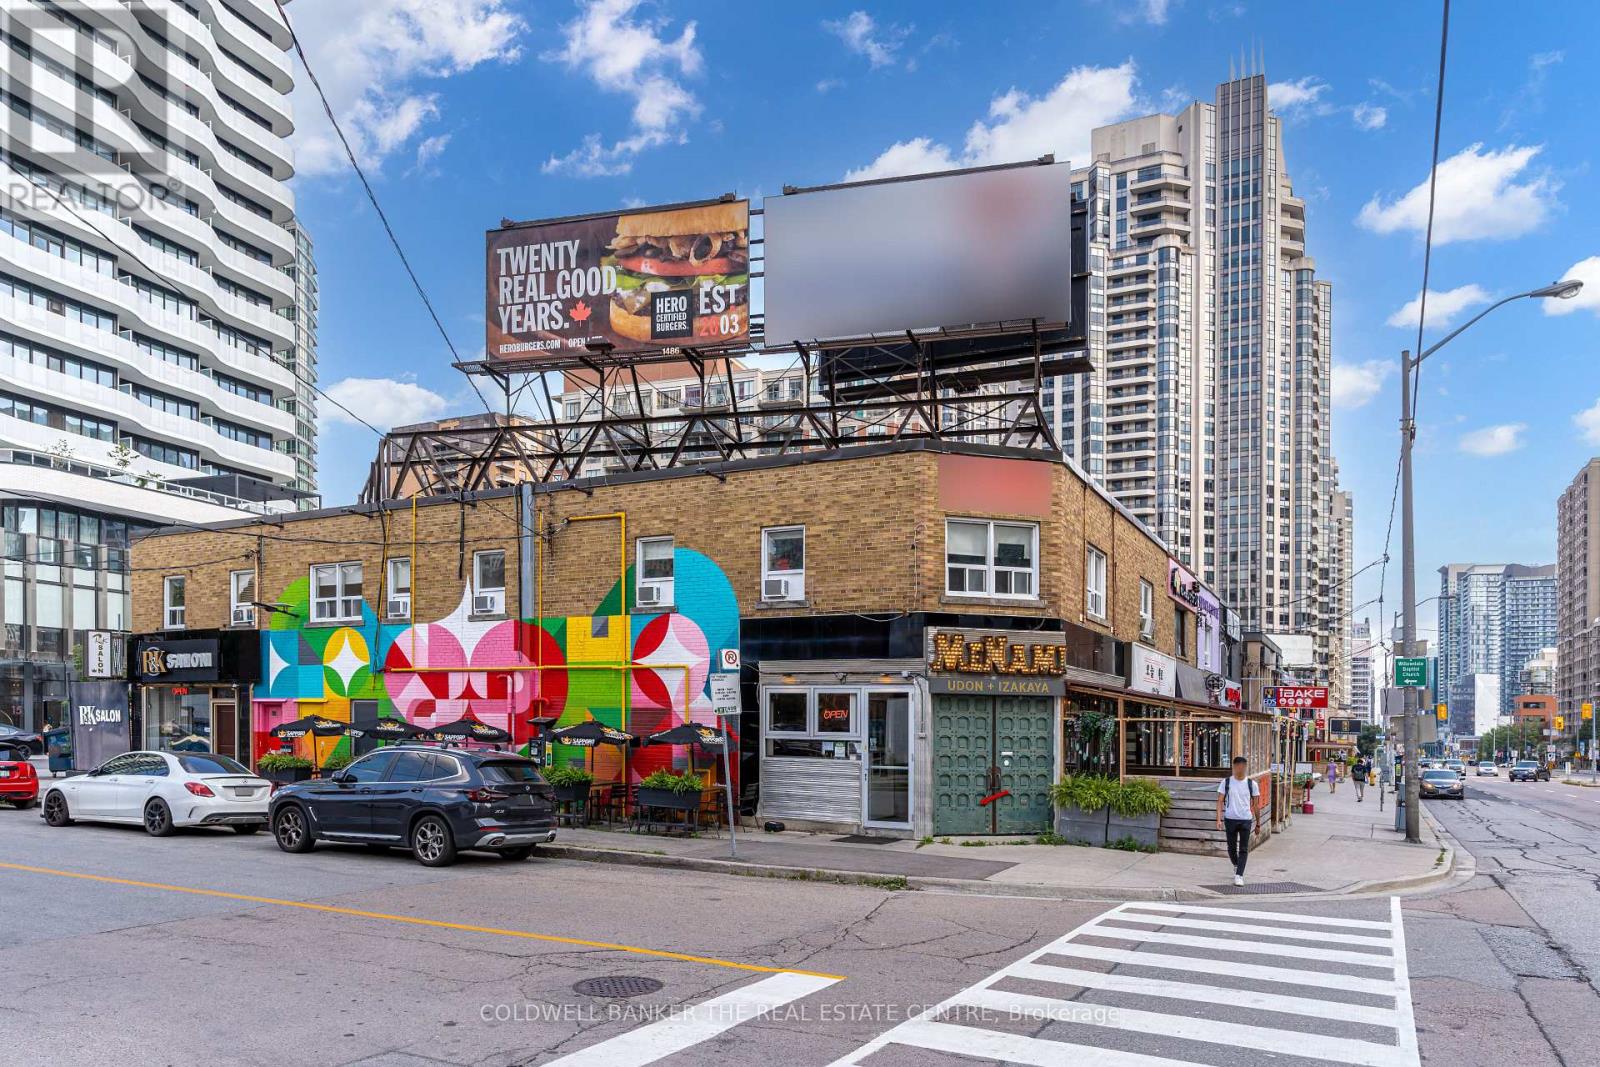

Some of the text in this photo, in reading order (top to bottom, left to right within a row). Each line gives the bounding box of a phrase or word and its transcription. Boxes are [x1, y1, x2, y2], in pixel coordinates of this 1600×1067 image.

[497, 239, 580, 275] TWENTY
[656, 296, 688, 313] HERO
[498, 301, 570, 334] YEARS.
[656, 312, 687, 323] CERTIFIED
[699, 314, 740, 337] 2003
[500, 339, 561, 354] HEROBURGERS.COM
[568, 338, 586, 348] OPEN
[662, 347, 680, 355] 1486
[166, 652, 213, 669] SALON
[172, 687, 189, 696] OPEN
[947, 680, 983, 691] UDON
[998, 682, 1049, 693] IZAKAYA
[95, 709, 121, 723] SALON
[823, 709, 848, 719] OPEN
